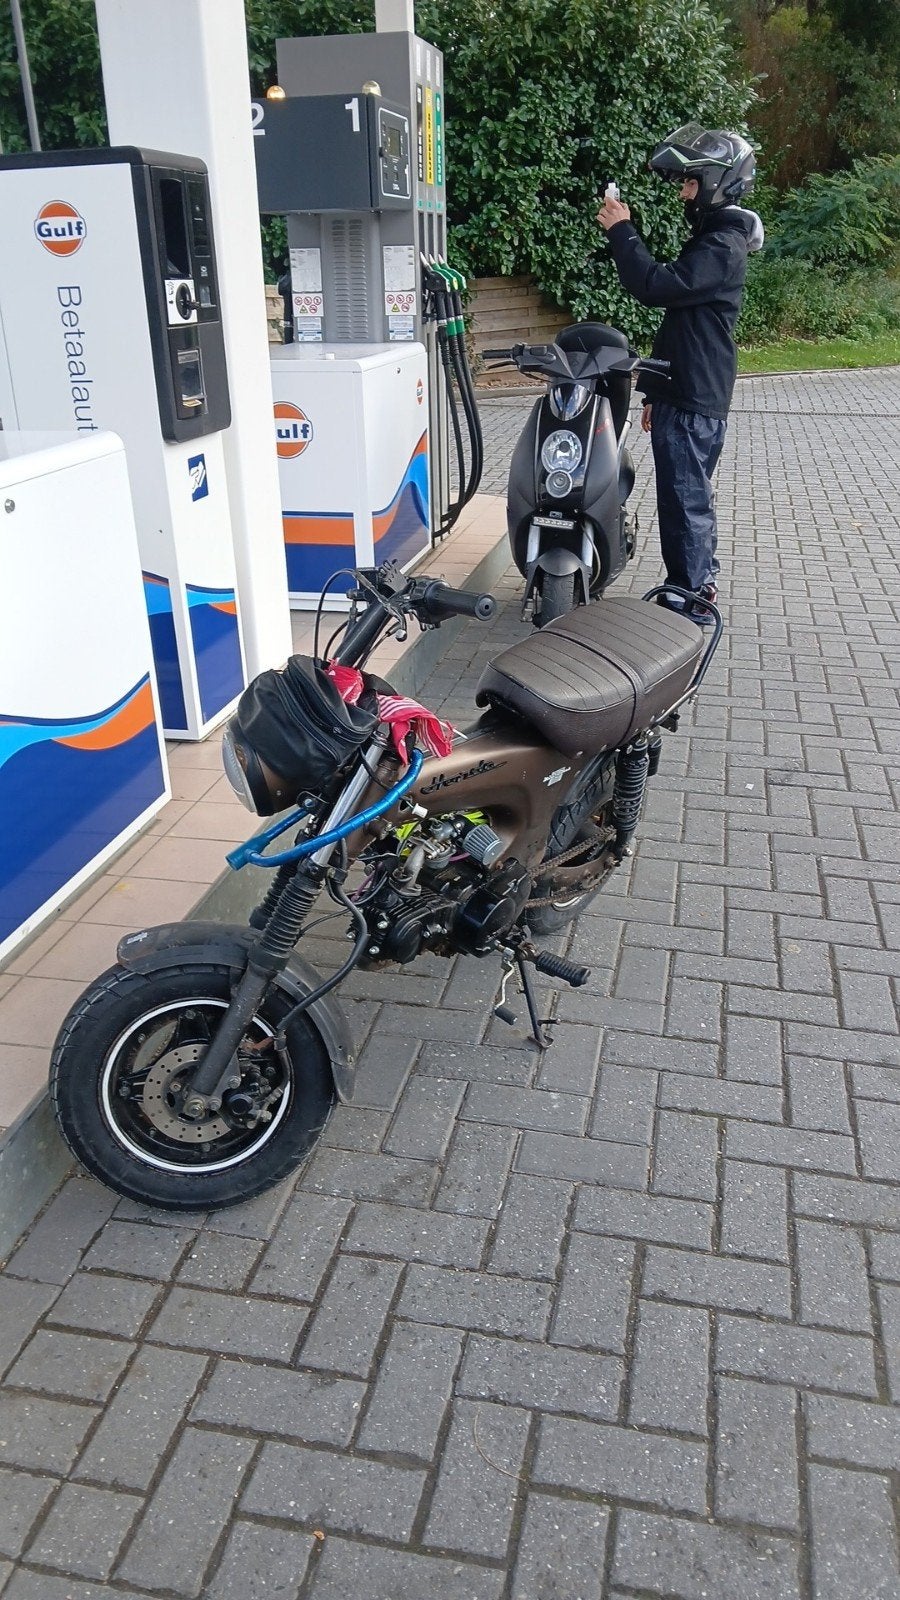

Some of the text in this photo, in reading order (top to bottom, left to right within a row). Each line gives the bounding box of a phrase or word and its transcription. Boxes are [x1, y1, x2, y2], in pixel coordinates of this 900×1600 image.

[251, 102, 266, 136] 2
[345, 98, 360, 132] 1
[36, 220, 84, 238] Gulf
[57, 285, 99, 431] Betaalaut
[277, 423, 310, 440] ulf
